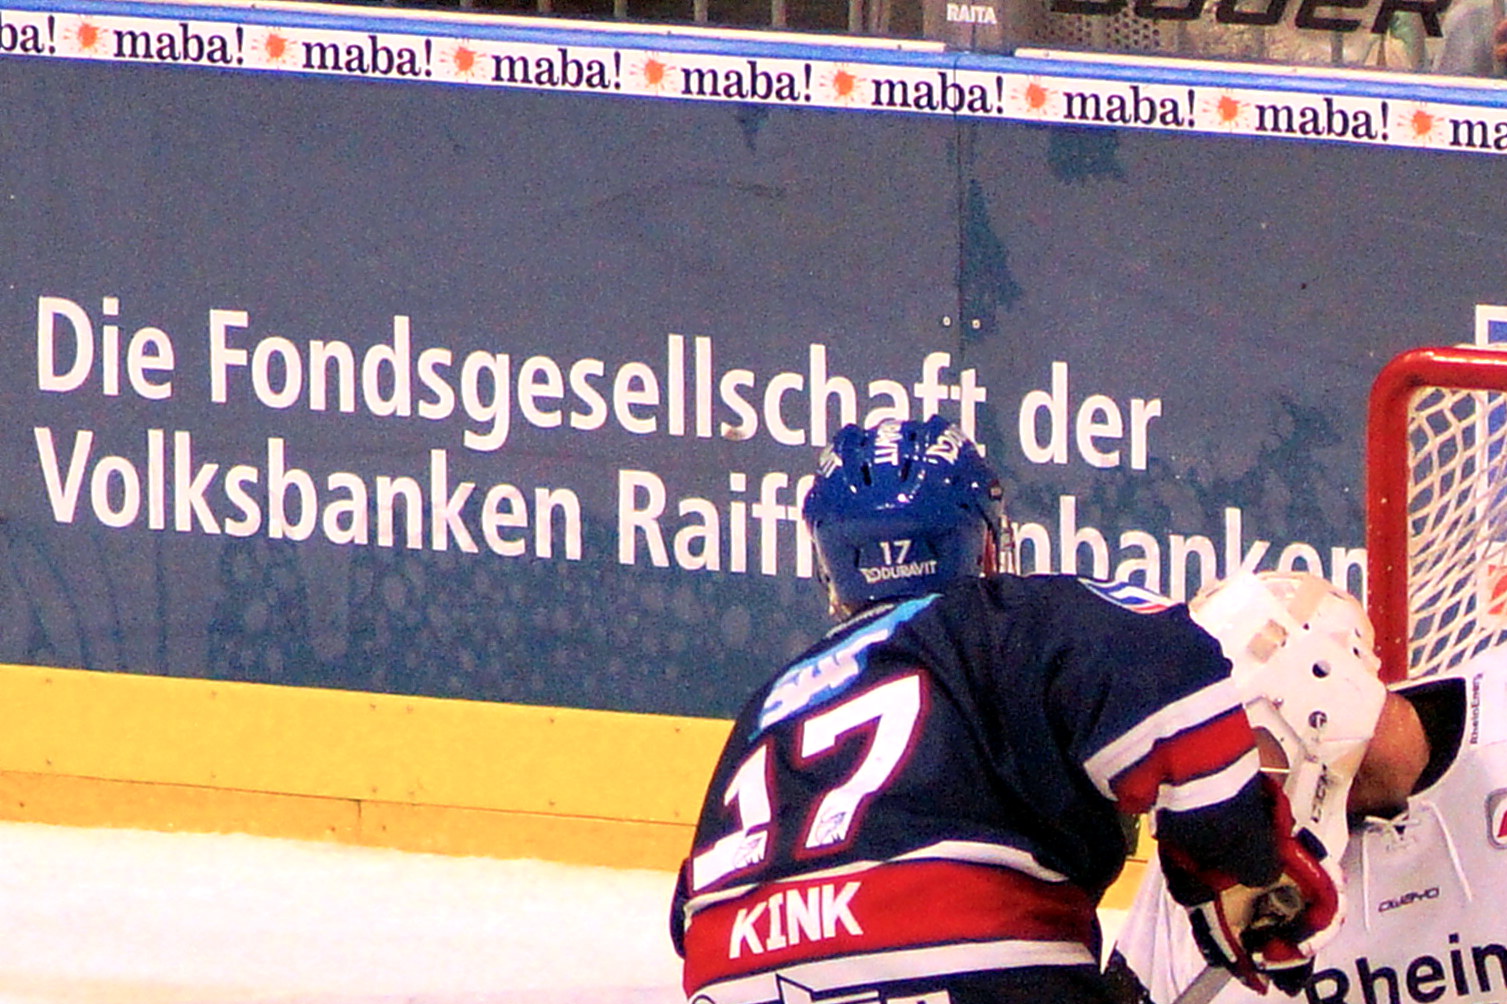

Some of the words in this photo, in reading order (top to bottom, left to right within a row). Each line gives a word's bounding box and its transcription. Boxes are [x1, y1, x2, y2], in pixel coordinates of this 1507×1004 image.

[114, 23, 244, 65] maba!
[303, 35, 432, 77] maba!
[492, 48, 622, 90] maba!
[681, 61, 812, 102] maba!
[872, 73, 1004, 114] maba!
[1064, 86, 1196, 128] maba!
[1255, 98, 1389, 141] maba!
[37, 296, 174, 399] Die
[209, 308, 987, 458] Fondsgesellschaft
[1018, 361, 1162, 470] der
[33, 427, 583, 562] Volksbanken
[880, 540, 911, 565] 17
[881, 560, 937, 580] DURAVIT
[692, 674, 922, 891] 17
[729, 881, 864, 959] KINK
